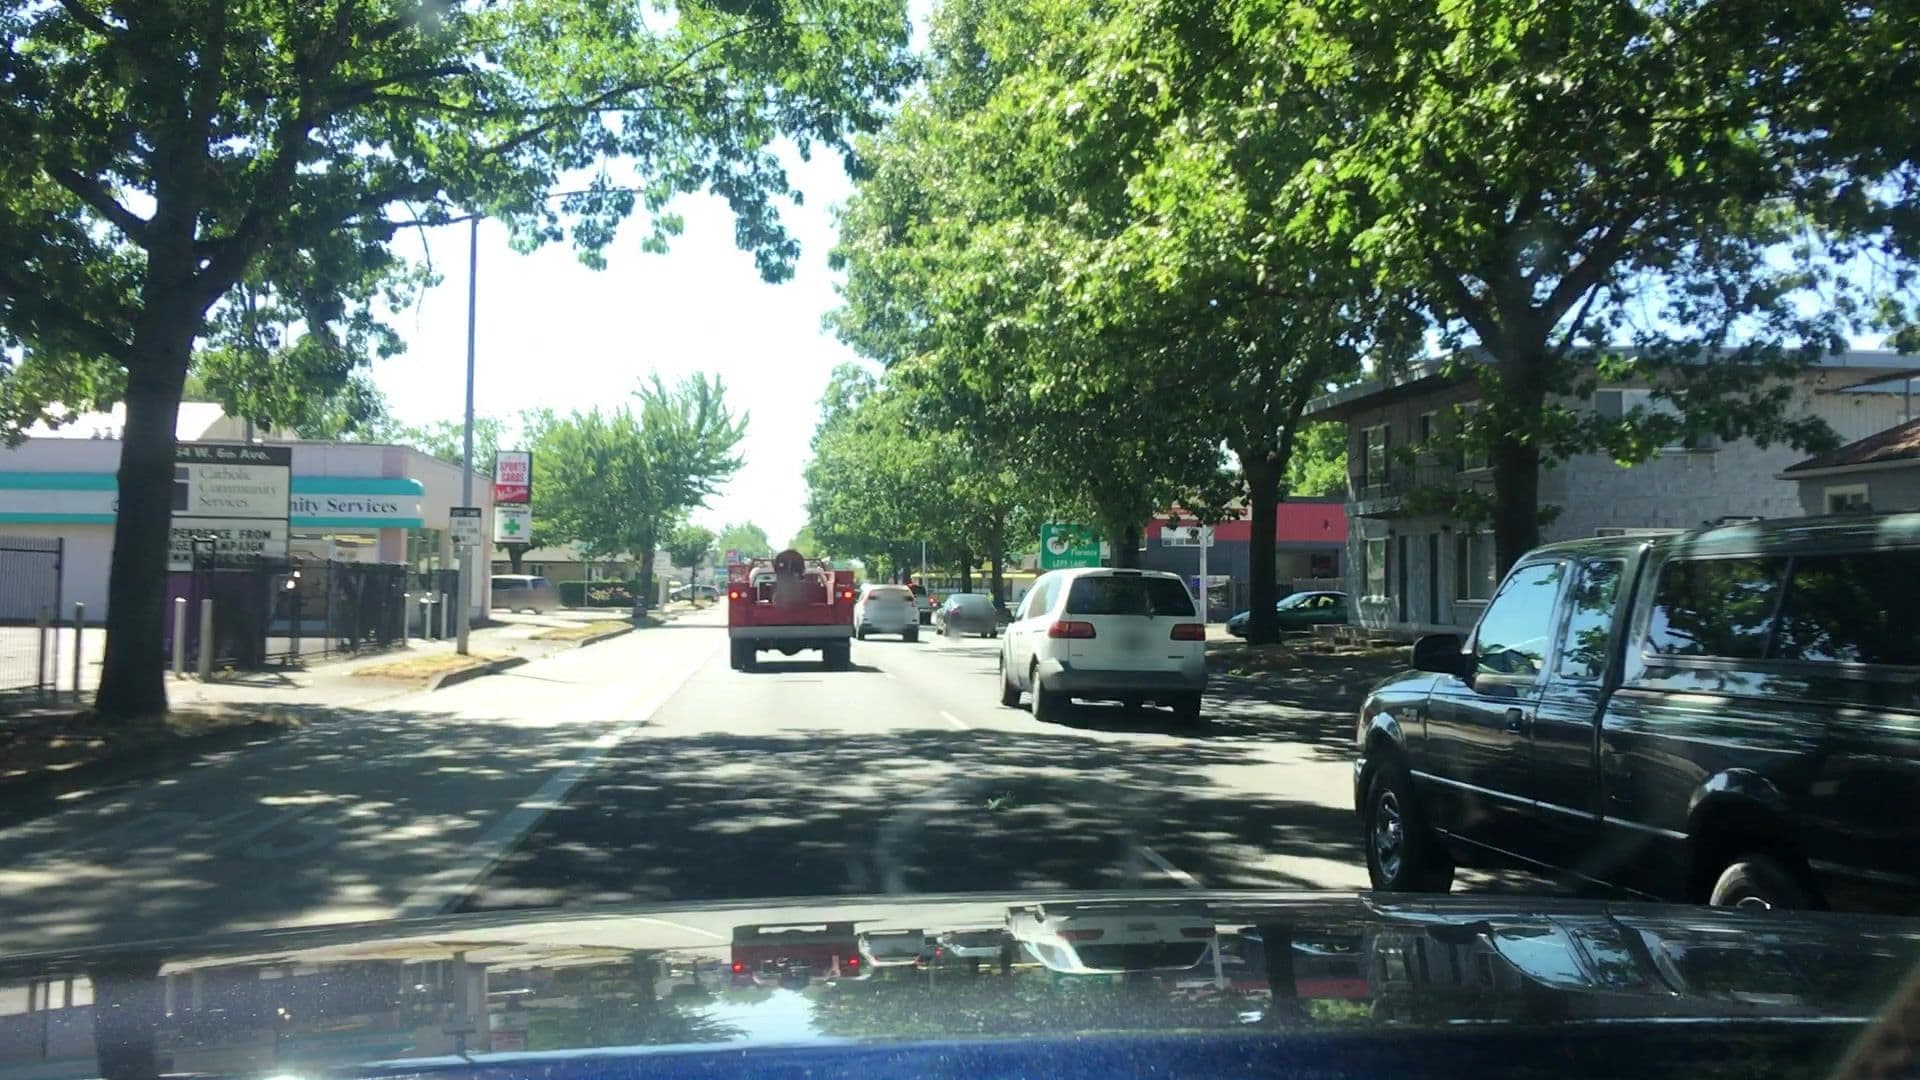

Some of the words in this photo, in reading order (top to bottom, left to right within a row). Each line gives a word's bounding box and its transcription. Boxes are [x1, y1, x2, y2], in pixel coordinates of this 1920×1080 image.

[194, 447, 214, 458] W.
[239, 449, 271, 460] Ave.
[500, 462, 527, 471] SPORTS
[199, 482, 276, 496] Community
[200, 497, 249, 508] Services
[327, 498, 398, 513] Services
[239, 529, 271, 540] FROM
